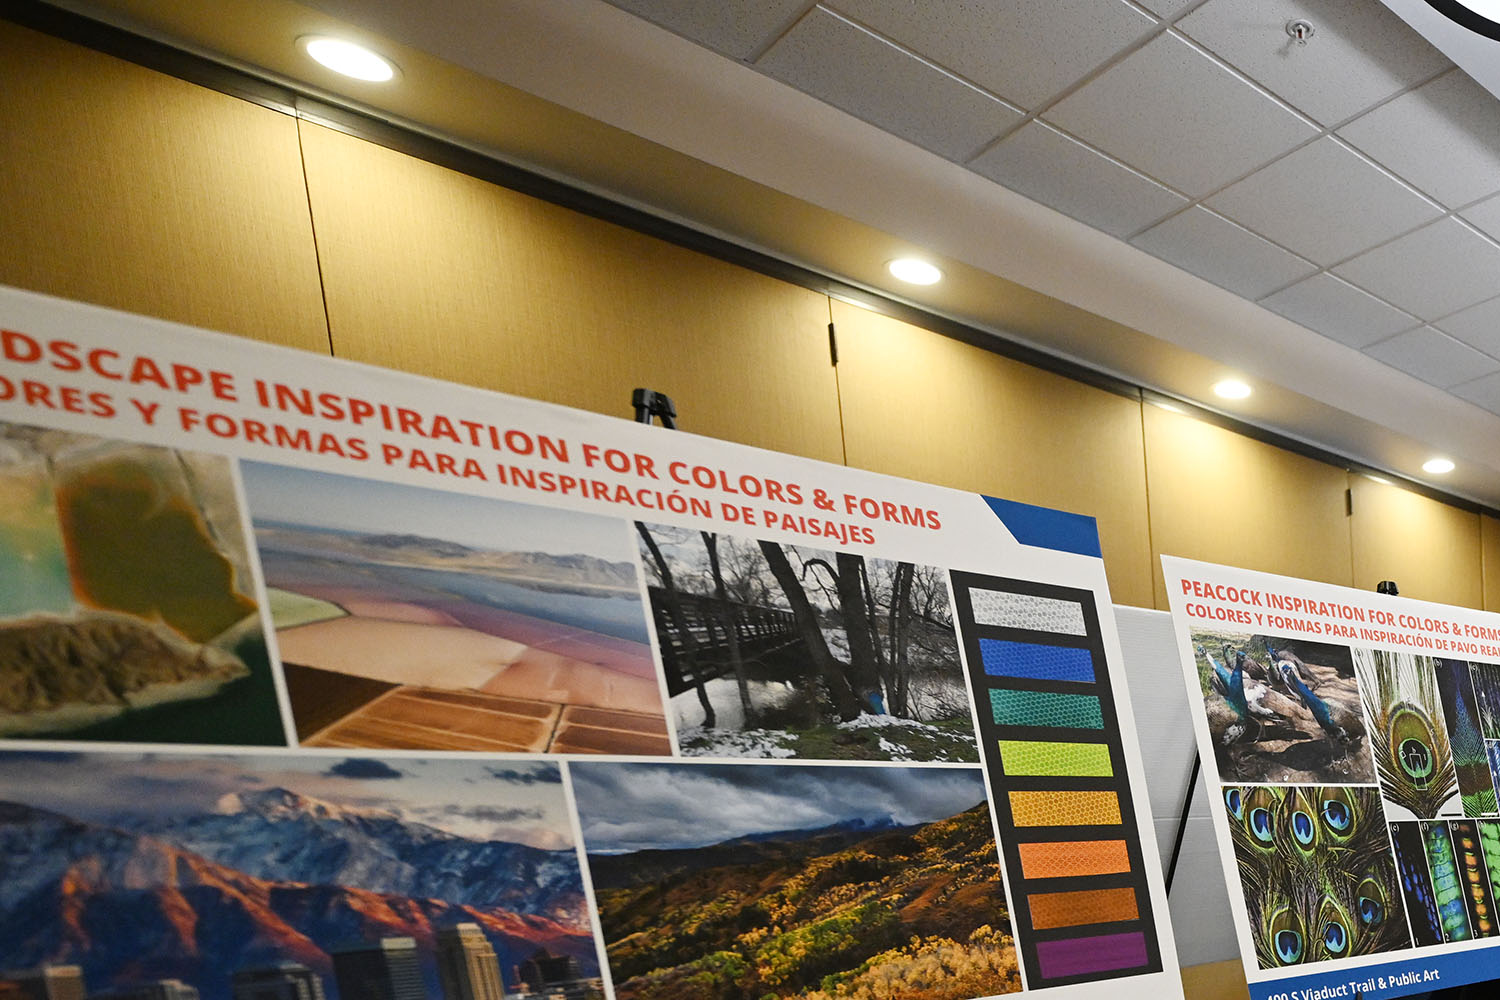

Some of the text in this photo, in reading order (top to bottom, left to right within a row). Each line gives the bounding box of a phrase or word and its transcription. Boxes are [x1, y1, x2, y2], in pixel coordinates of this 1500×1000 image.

[131, 400, 159, 424] Y
[179, 408, 368, 460] FORMAS
[382, 444, 487, 480] PARA
[497, 464, 712, 518] INSPIRACIÓN
[722, 504, 756, 525] DE
[763, 510, 875, 544] PAISAJES
[256, 380, 569, 463] INSPIRATION
[582, 444, 658, 479] FOR
[669, 462, 803, 504] COLORS
[814, 489, 836, 512] &
[844, 494, 941, 530] FORMS
[1181, 579, 1262, 606] PEACOCK
[1266, 593, 1365, 622] INSPIRATION
[1369, 610, 1396, 626] FOR
[1399, 615, 1449, 634] COLORS
[1453, 623, 1462, 635] &
[1186, 603, 1251, 624] COLORES
[1254, 613, 1263, 625] Y
[1267, 615, 1321, 634] FORMAS
[1325, 624, 1358, 638] PARA
[1360, 629, 1433, 648] INSPIRACIÓN
[1435, 639, 1448, 650] DE
[1451, 641, 1478, 654] PAVO
[1415, 937, 1419, 945] 1
[1445, 932, 1450, 941] 2
[1474, 929, 1478, 938] 3
[1349, 978, 1376, 994] Trail
[1378, 977, 1387, 990] &
[1389, 972, 1421, 988] Public
[1424, 968, 1440, 982] Art
